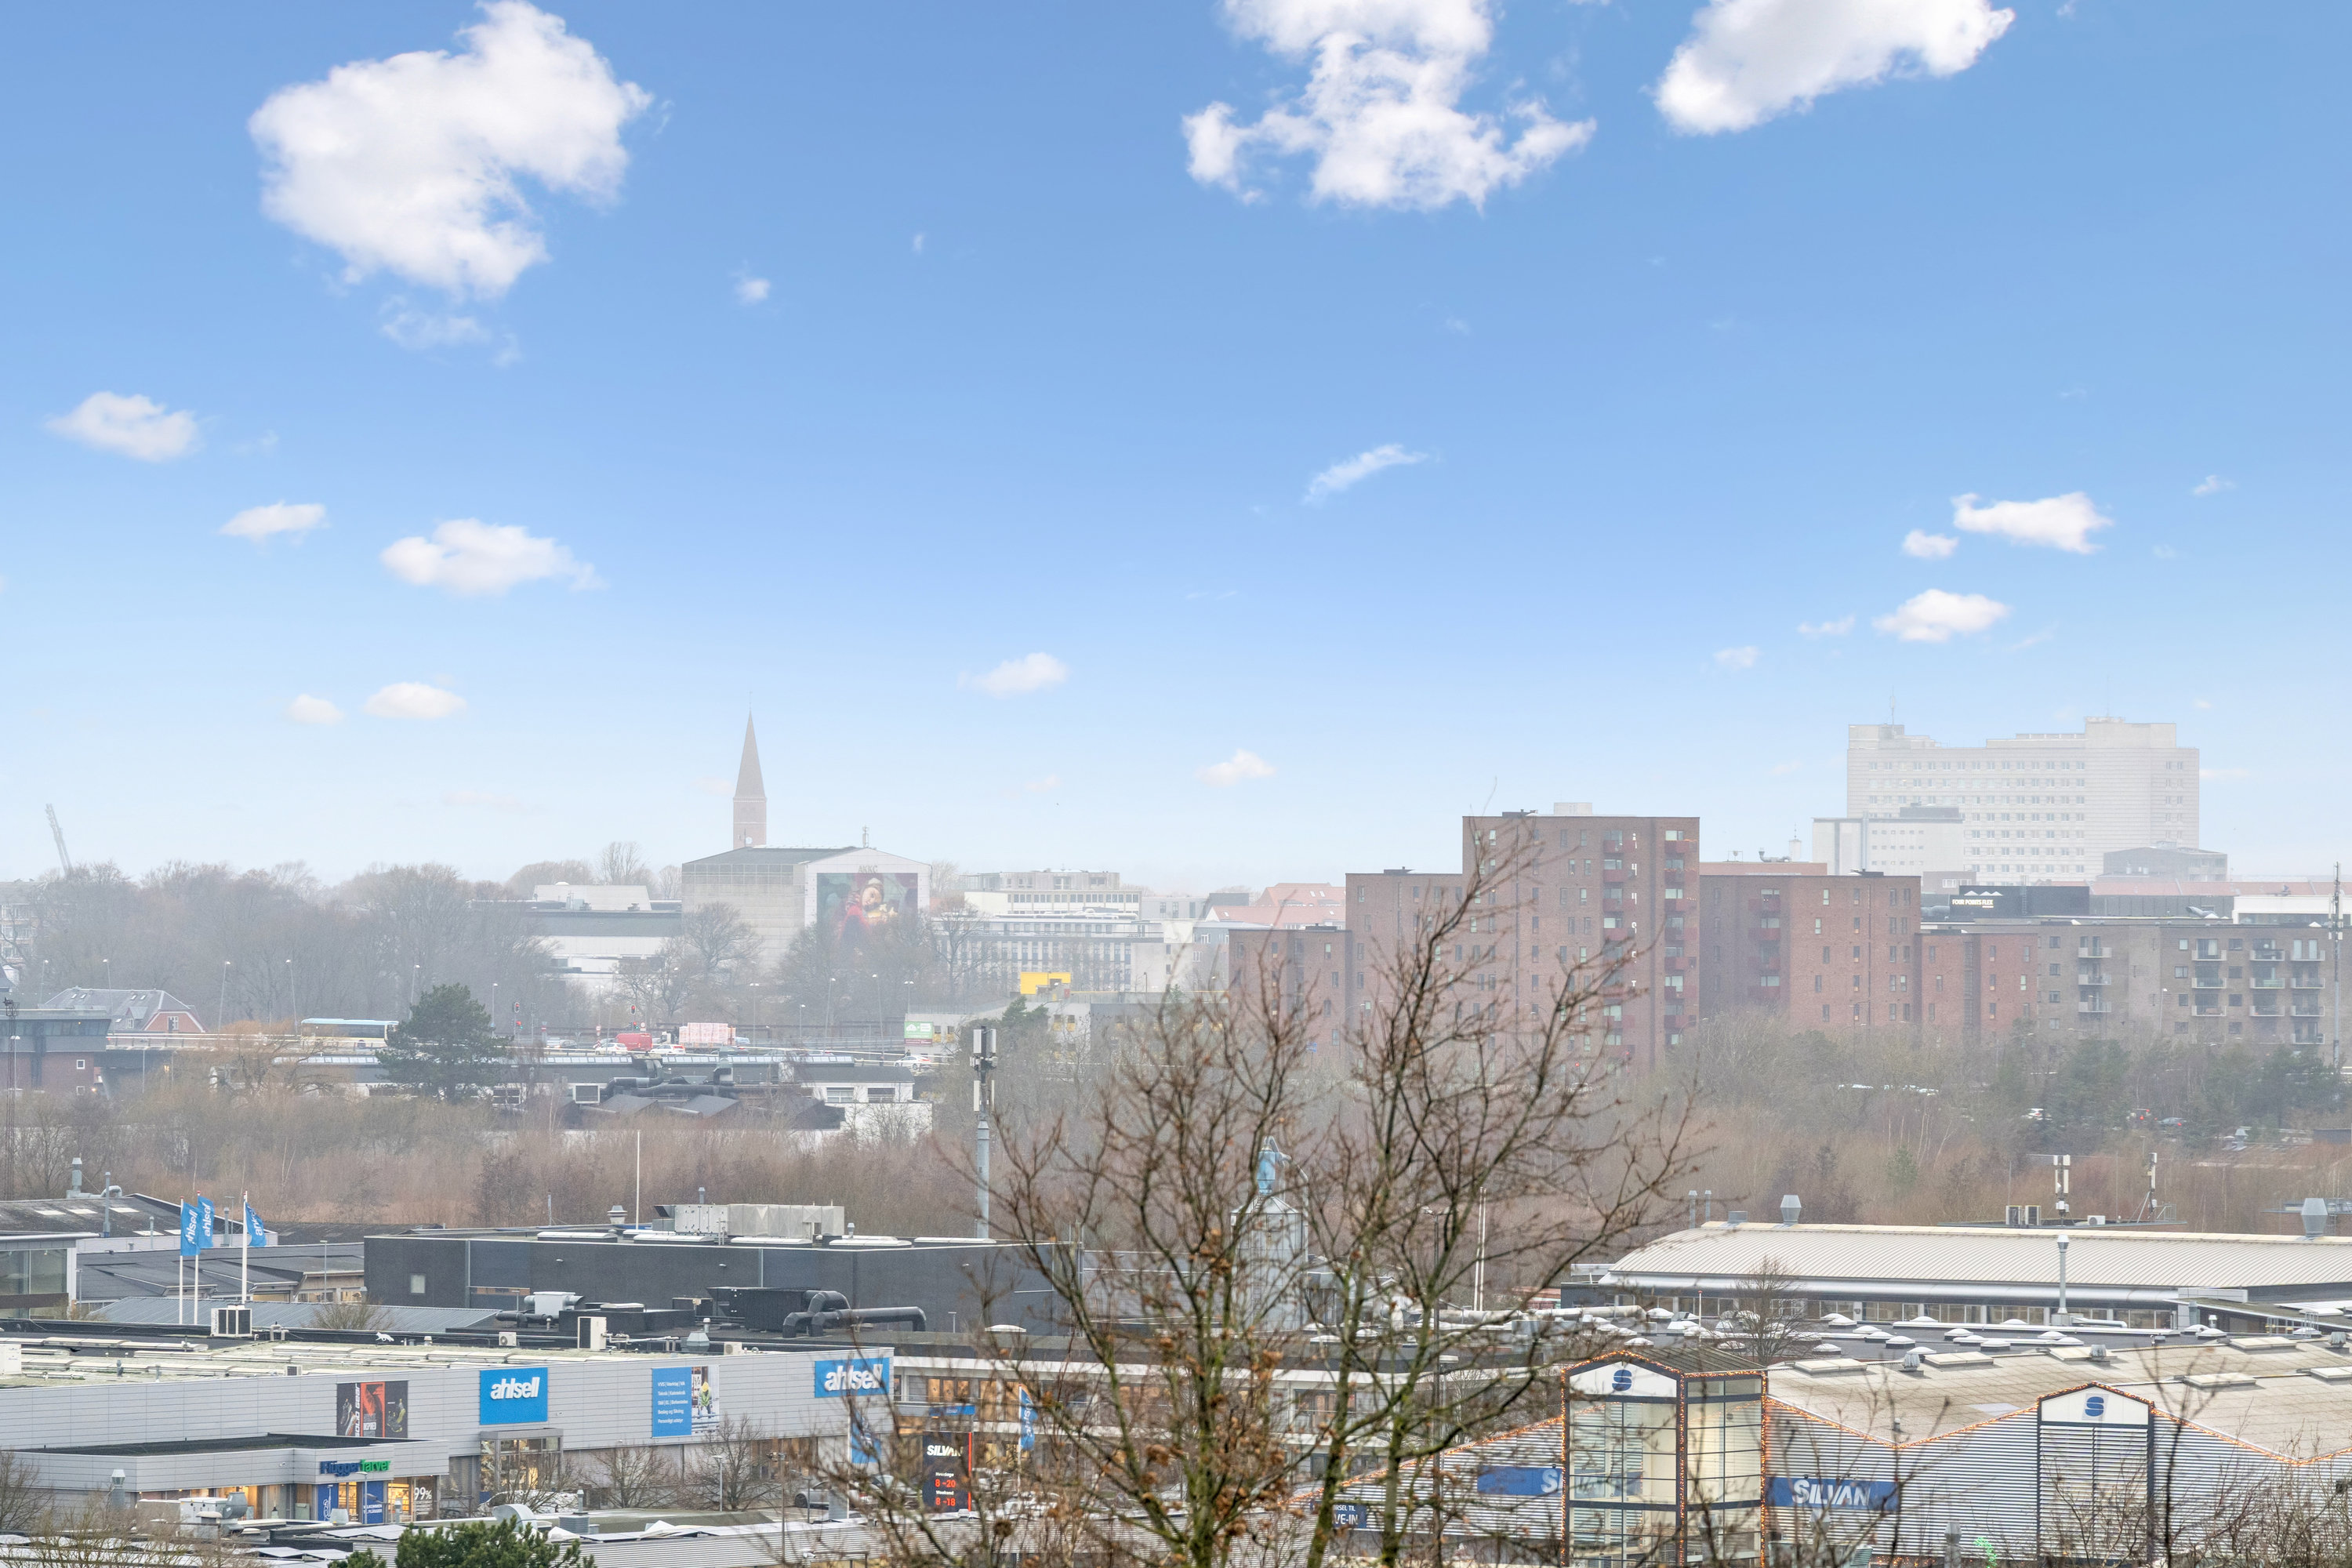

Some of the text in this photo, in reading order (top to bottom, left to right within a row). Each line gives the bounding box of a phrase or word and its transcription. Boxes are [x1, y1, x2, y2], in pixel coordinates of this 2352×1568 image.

[825, 1364, 884, 1391] ahlsell
[491, 1377, 540, 1400] ahlsell
[927, 1445, 964, 1457] SILVAN
[360, 1459, 391, 1472] farver
[935, 1479, 941, 1488] 8
[1792, 1479, 1871, 1506] SILVAN
[935, 1497, 942, 1506] 8
